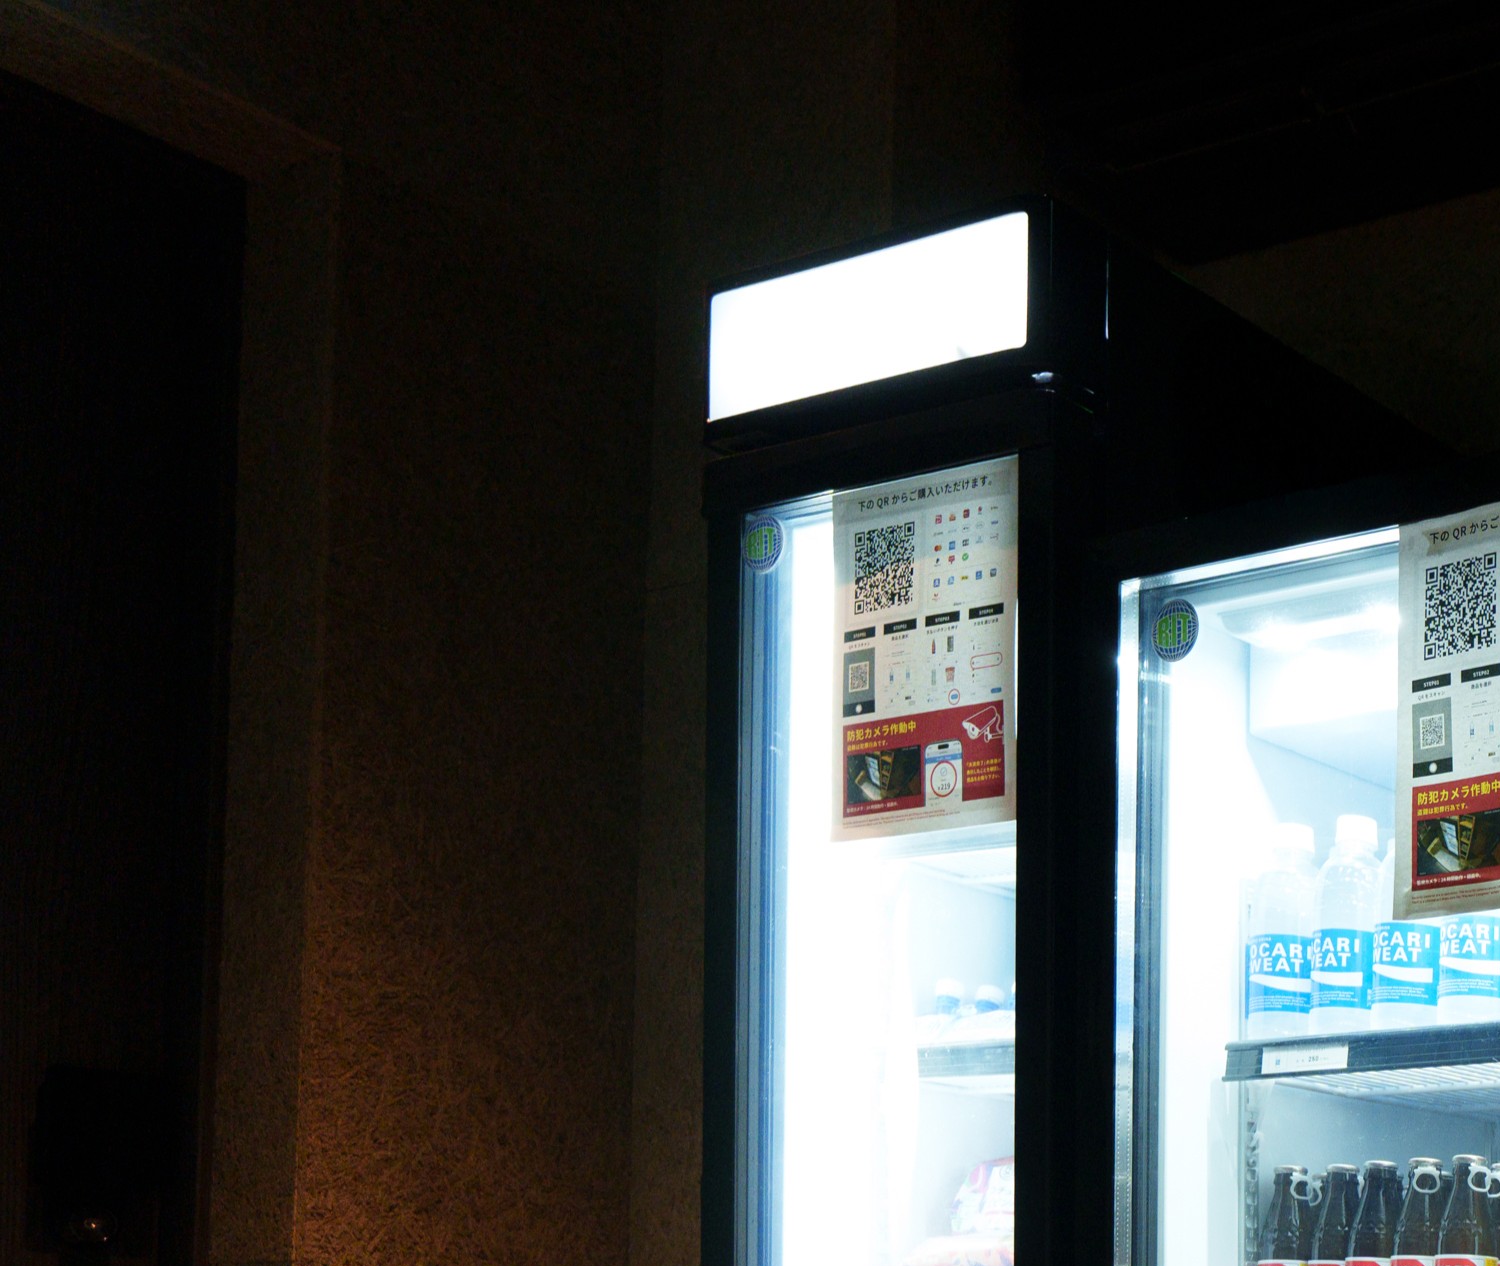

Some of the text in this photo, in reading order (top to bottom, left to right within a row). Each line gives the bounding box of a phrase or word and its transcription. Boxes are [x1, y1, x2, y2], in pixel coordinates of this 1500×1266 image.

[1453, 524, 1467, 539] QR
[1157, 612, 1190, 648] RIT
[847, 720, 916, 742] 防犯カメラ作動中
[1417, 779, 1500, 806] 防犯カメラ作動中
